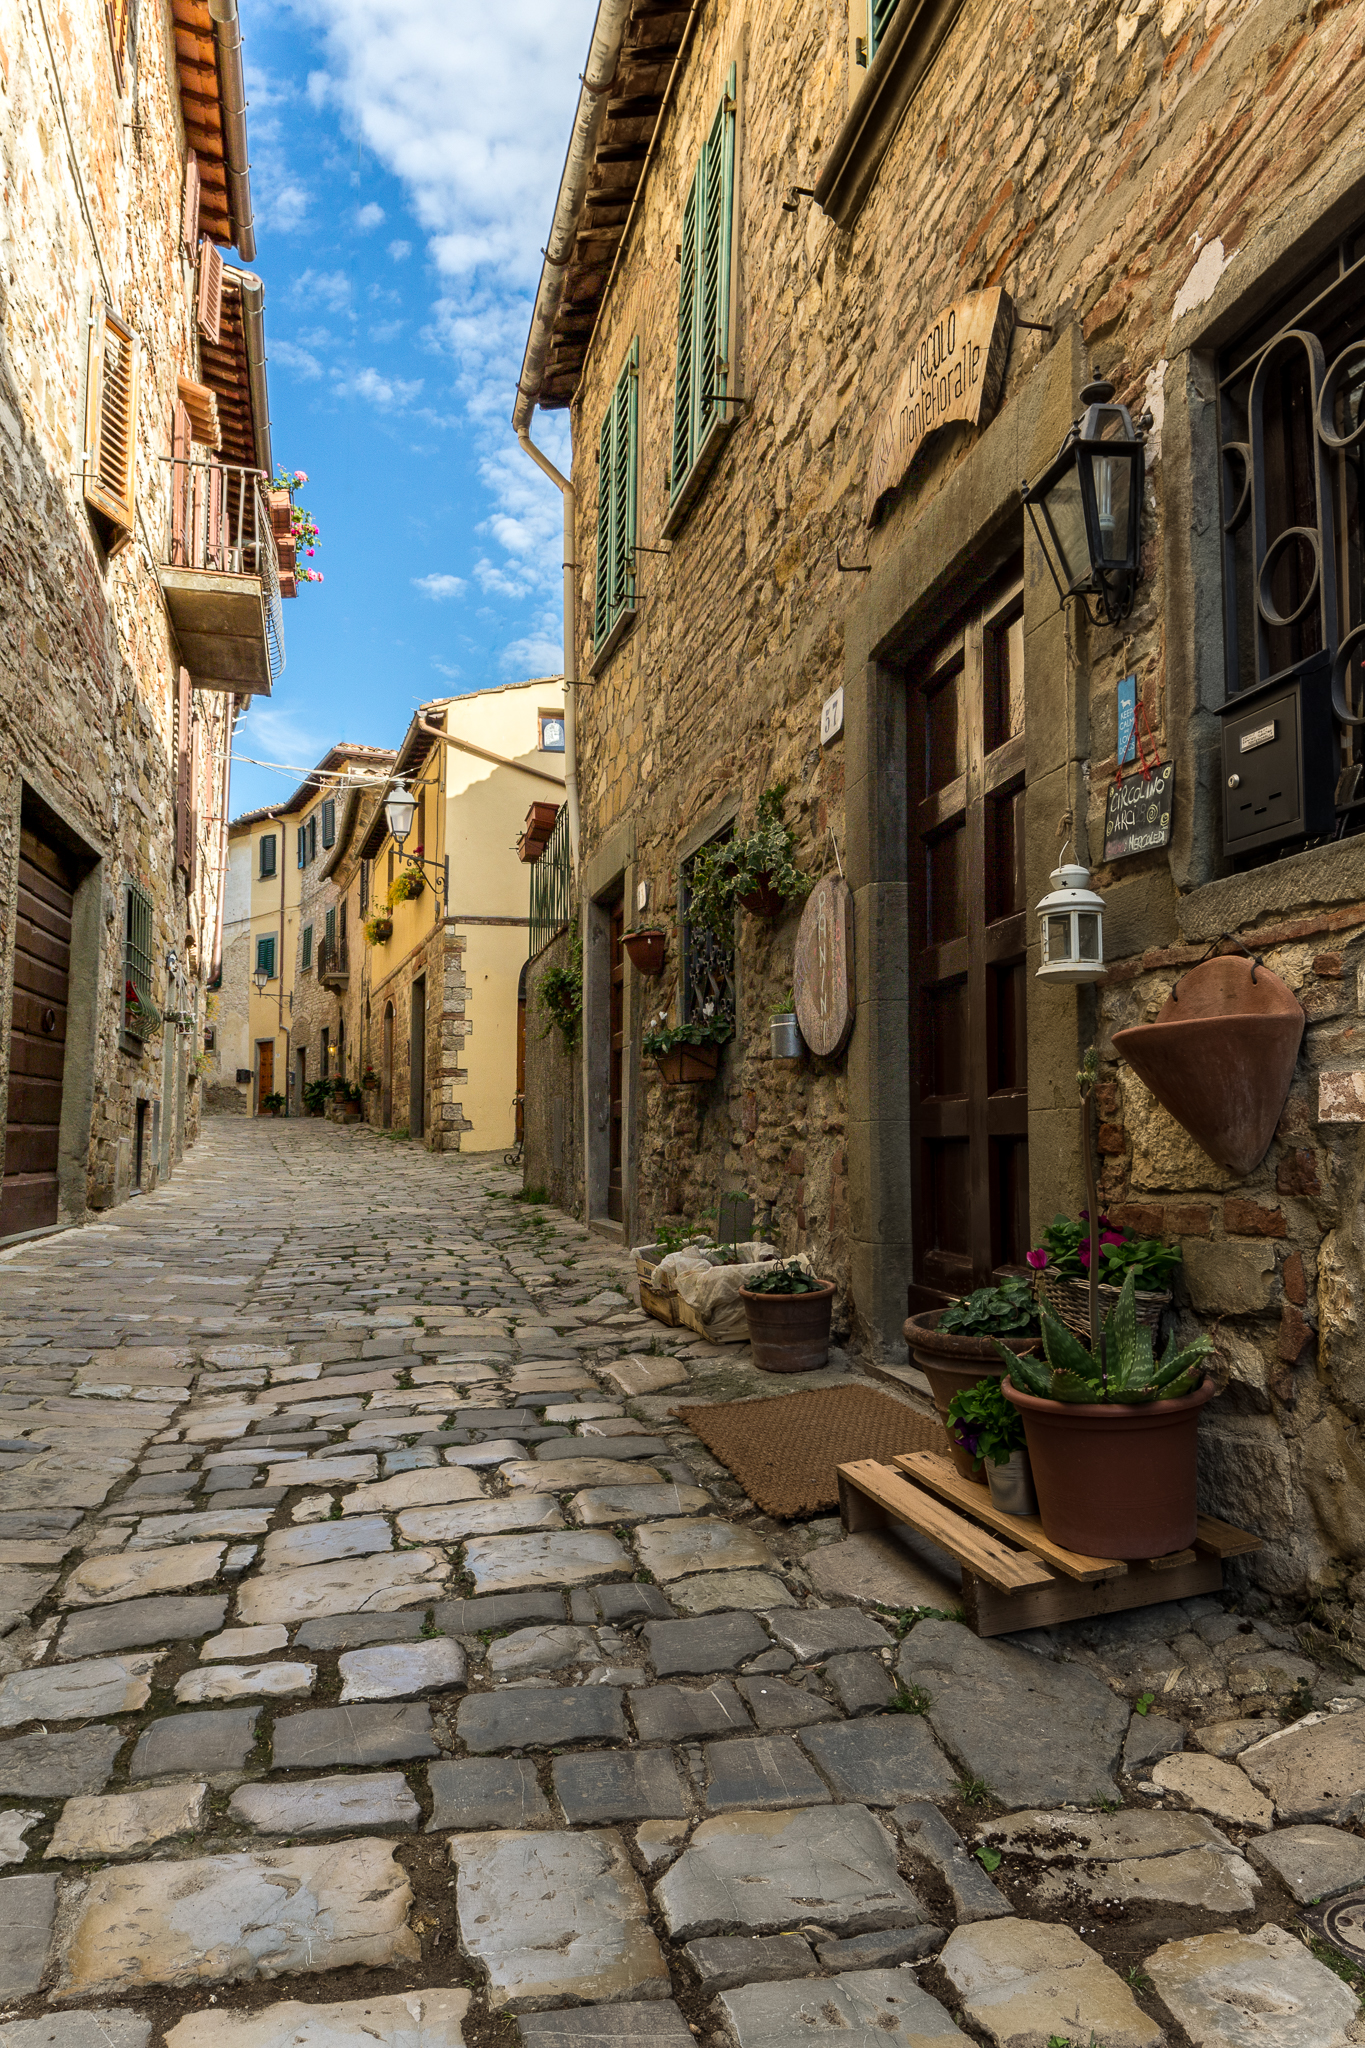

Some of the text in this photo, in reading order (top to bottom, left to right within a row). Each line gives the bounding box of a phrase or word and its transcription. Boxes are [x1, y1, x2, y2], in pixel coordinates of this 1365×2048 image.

[908, 310, 956, 398] CIRCOLO
[824, 700, 838, 734] 57
[1119, 716, 1136, 731] CALM
[1120, 707, 1135, 721] KEEP
